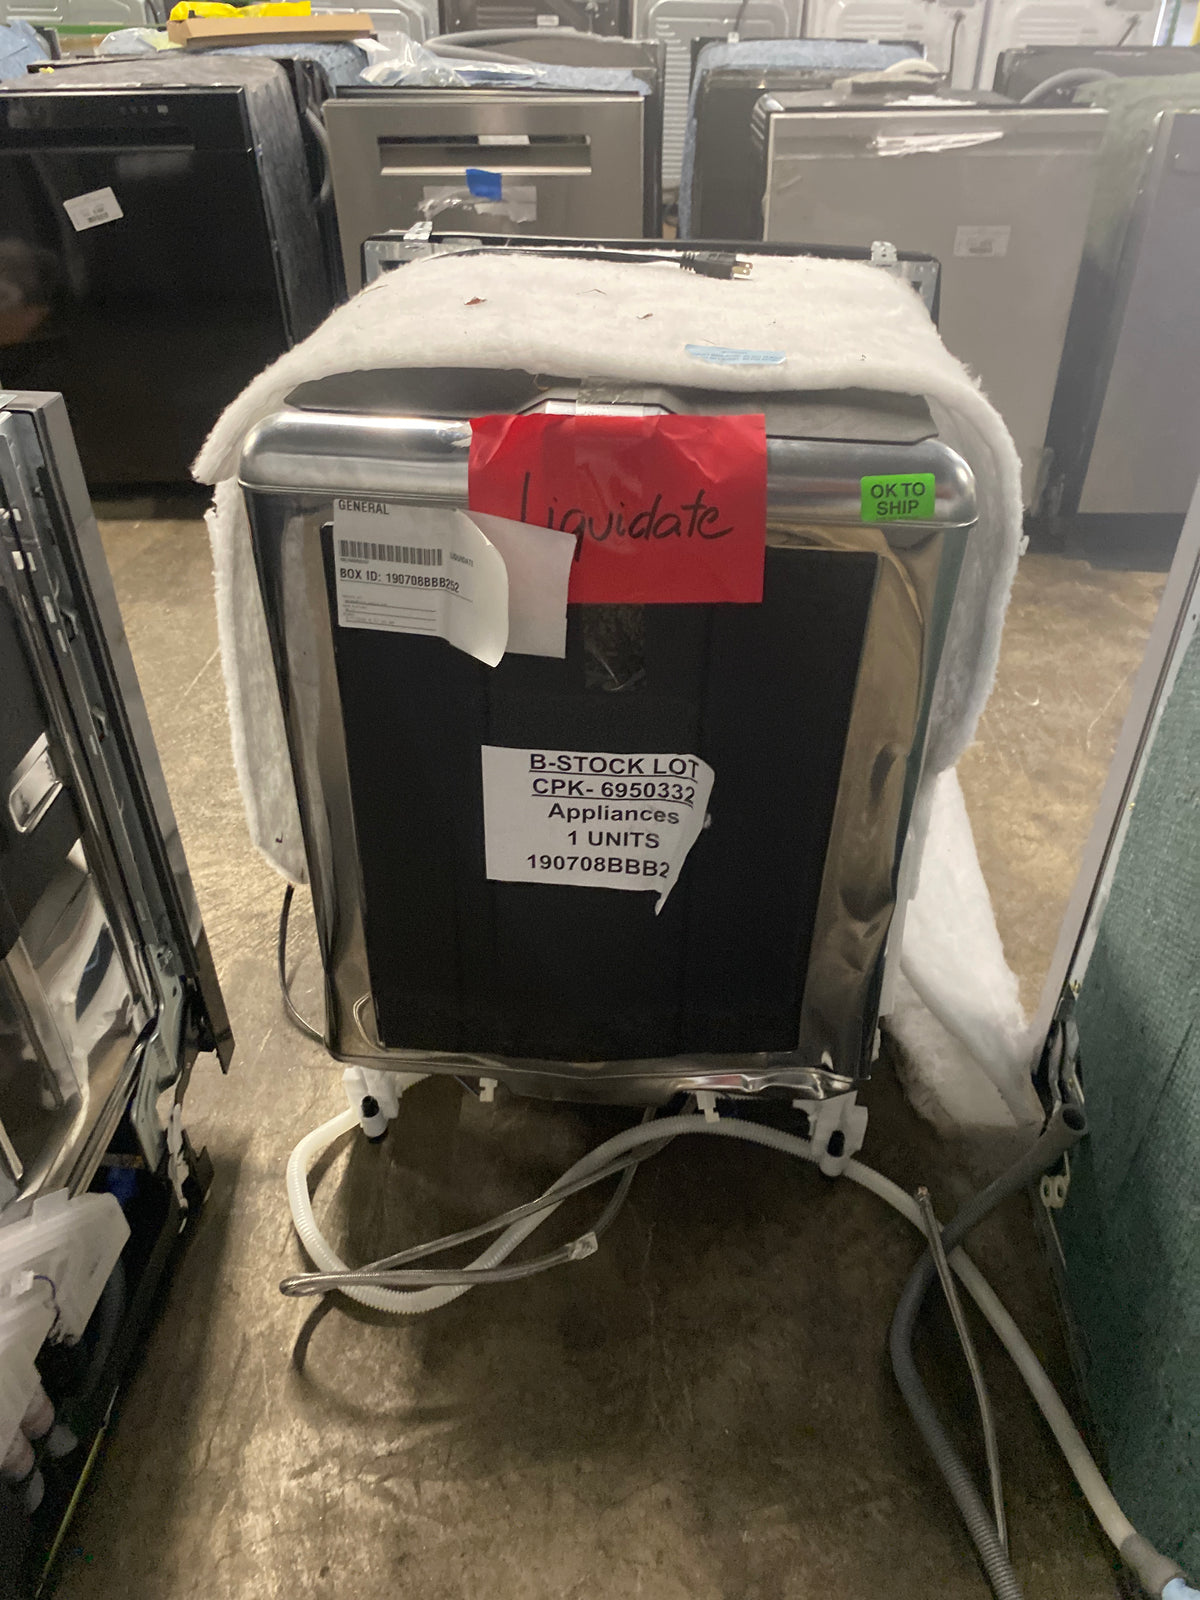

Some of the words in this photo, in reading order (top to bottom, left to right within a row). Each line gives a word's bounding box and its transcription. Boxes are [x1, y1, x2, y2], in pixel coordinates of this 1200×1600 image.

[871, 483, 898, 499] OK
[901, 481, 926, 497] TO
[338, 499, 390, 515] GENERAL
[876, 500, 920, 516] SHIP
[340, 568, 362, 580] BOX
[366, 570, 381, 582] ID:
[386, 573, 460, 593] 190708BBB252
[530, 753, 644, 774] B-STOCK
[653, 758, 699, 778] LOT
[532, 778, 594, 796] CPK-
[601, 782, 695, 803] 6950332
[548, 803, 680, 825] Appliances
[568, 830, 578, 846] 1
[588, 831, 660, 849] UNITS
[527, 854, 670, 879] 190708BBB2
